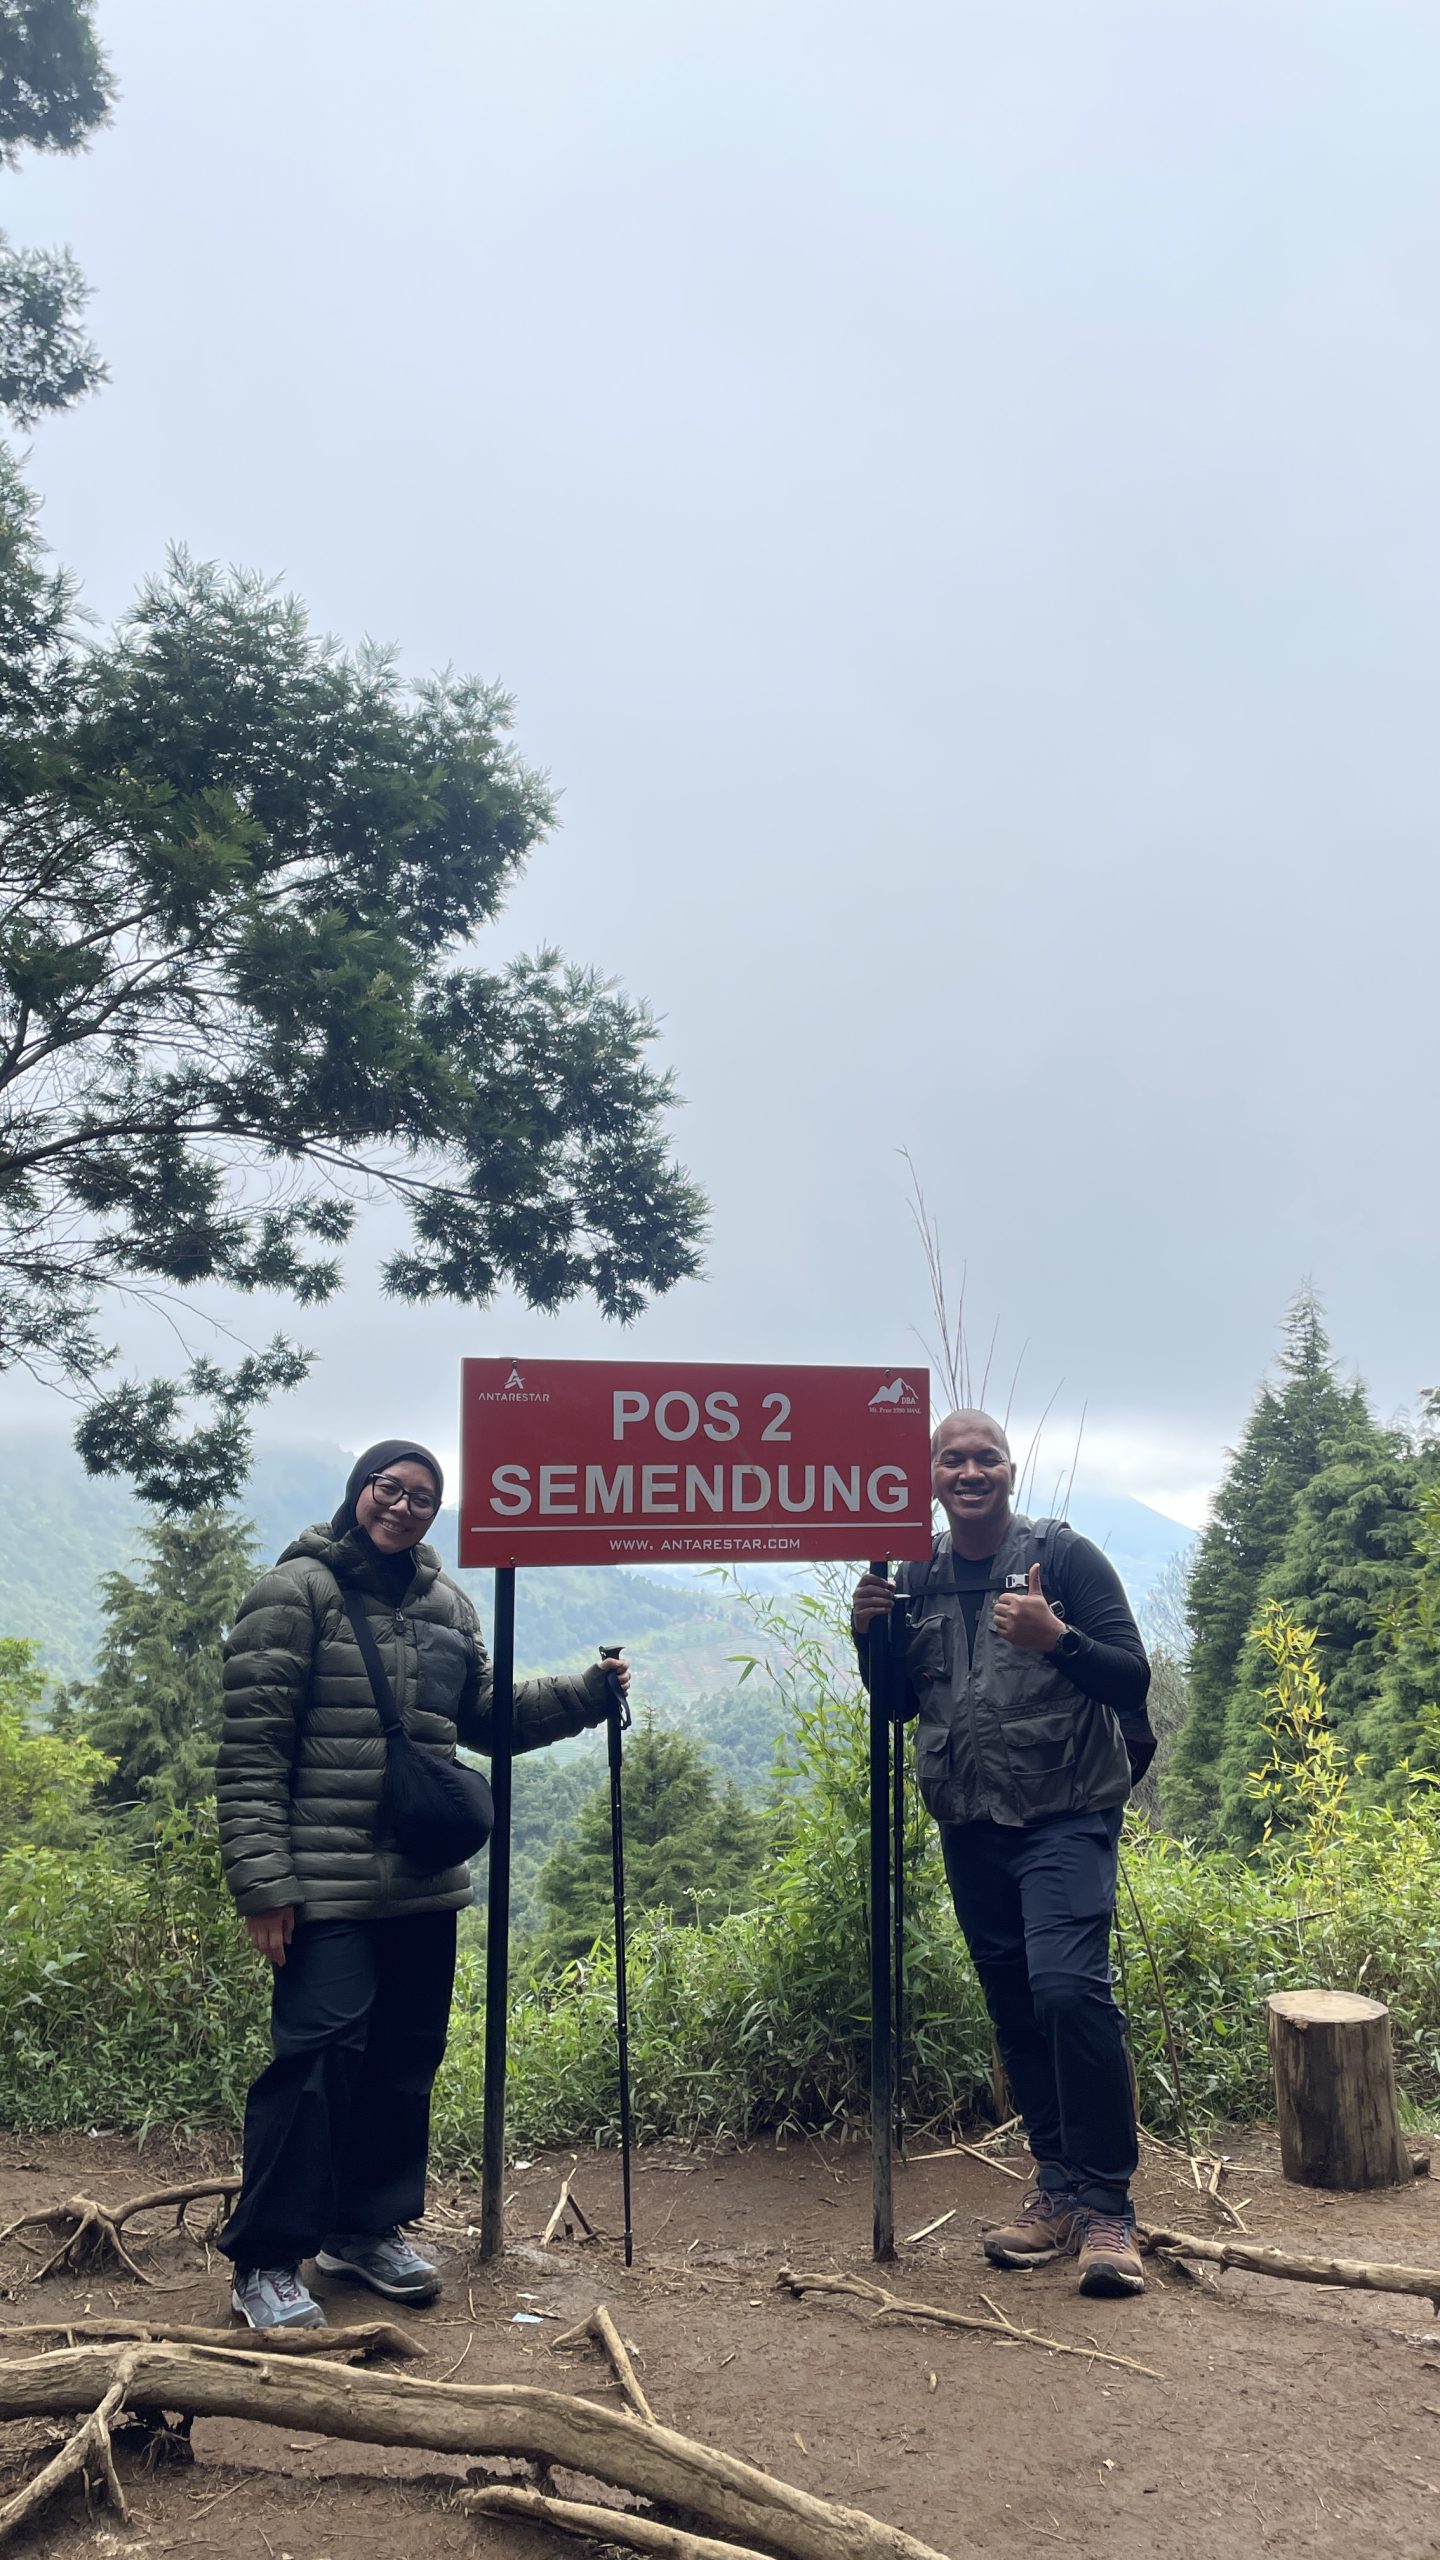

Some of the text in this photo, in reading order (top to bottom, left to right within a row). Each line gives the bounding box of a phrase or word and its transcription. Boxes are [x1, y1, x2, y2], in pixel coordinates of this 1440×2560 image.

[478, 1392, 550, 1402] ANTARESTAR
[901, 1396, 916, 1405] DBA
[613, 1390, 792, 1442] POS 2
[489, 1464, 909, 1516] SEMENDUNG
[609, 1538, 800, 1551] WWW. ANTARESTAR.COM
